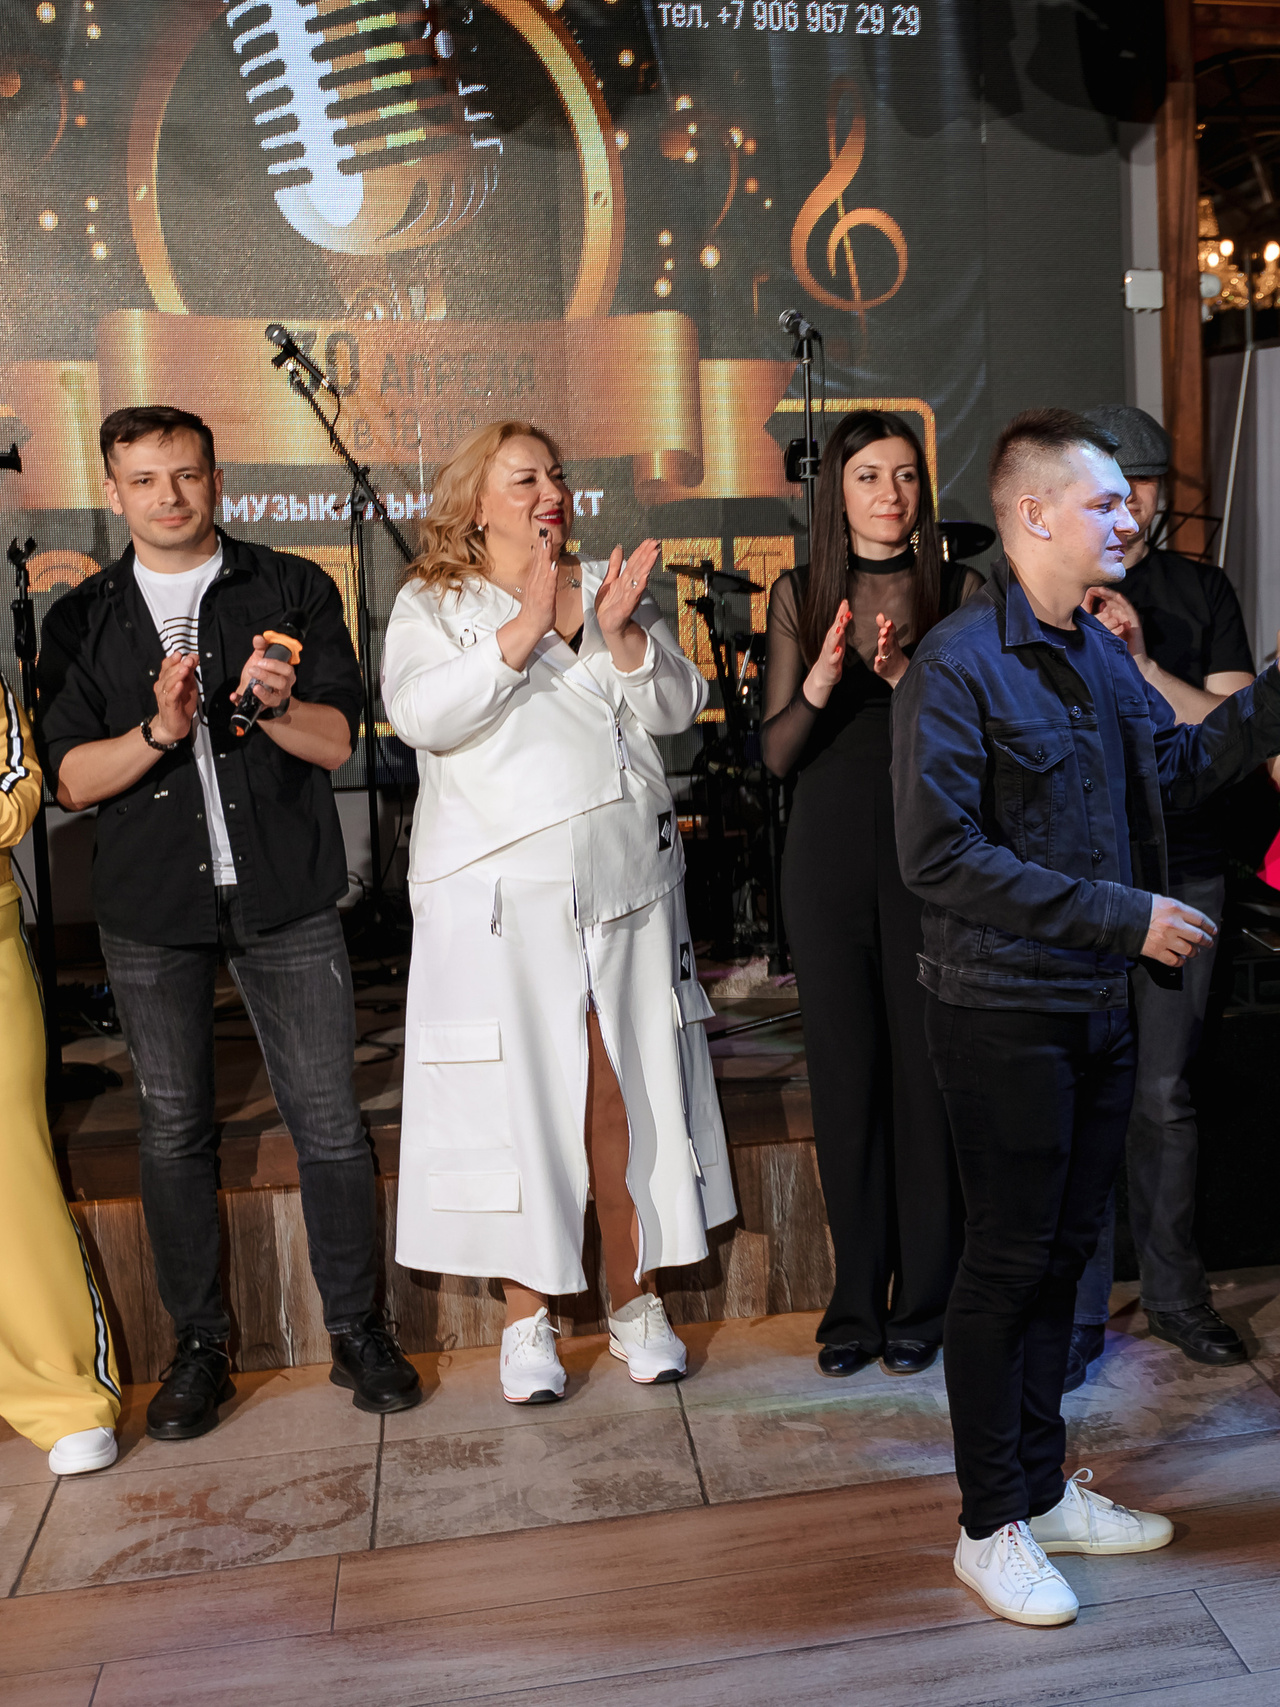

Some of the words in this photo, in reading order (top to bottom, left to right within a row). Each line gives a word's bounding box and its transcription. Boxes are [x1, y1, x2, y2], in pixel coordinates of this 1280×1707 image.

[658, 2, 709, 29] тел.
[717, 0, 744, 30] +7
[752, 0, 799, 32] 906
[806, 2, 848, 34] 967
[855, 3, 885, 35] 29
[892, 4, 921, 36] 29
